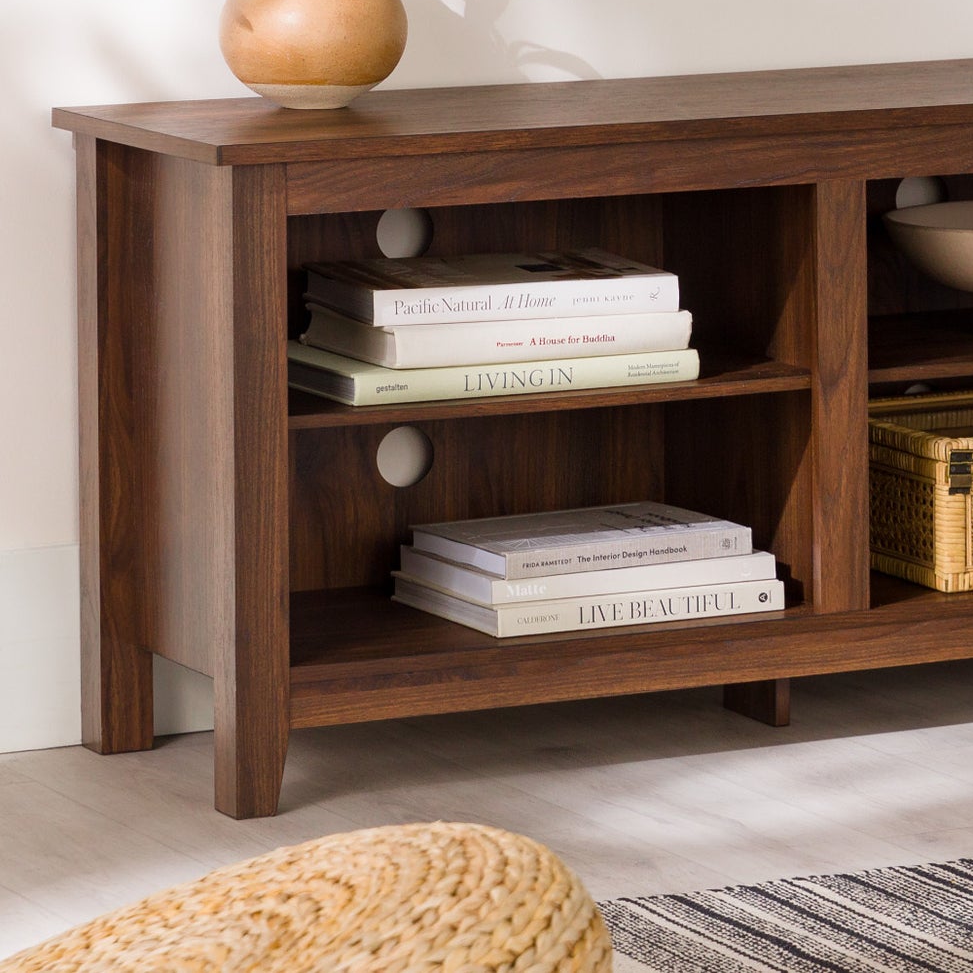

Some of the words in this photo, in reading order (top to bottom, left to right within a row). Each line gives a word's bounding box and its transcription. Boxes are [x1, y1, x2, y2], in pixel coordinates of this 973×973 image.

[394, 298, 439, 315] Pacific
[442, 295, 491, 312] Natural
[498, 294, 514, 309] At
[518, 292, 556, 308] Home
[530, 337, 536, 346] A
[539, 336, 566, 346] House
[567, 335, 580, 344] for
[582, 334, 615, 344] Buddha
[375, 383, 408, 394] gestalten
[464, 370, 543, 392] LIVING
[550, 367, 574, 385] IN
[541, 558, 572, 567] RAMSTEDT
[577, 555, 591, 564] The
[592, 551, 620, 562] Interior
[622, 549, 648, 560] Design
[650, 545, 688, 556] Handbook
[506, 582, 547, 599] Matte
[579, 601, 624, 625] LIVE
[629, 591, 741, 620] BEAUTIFUL
